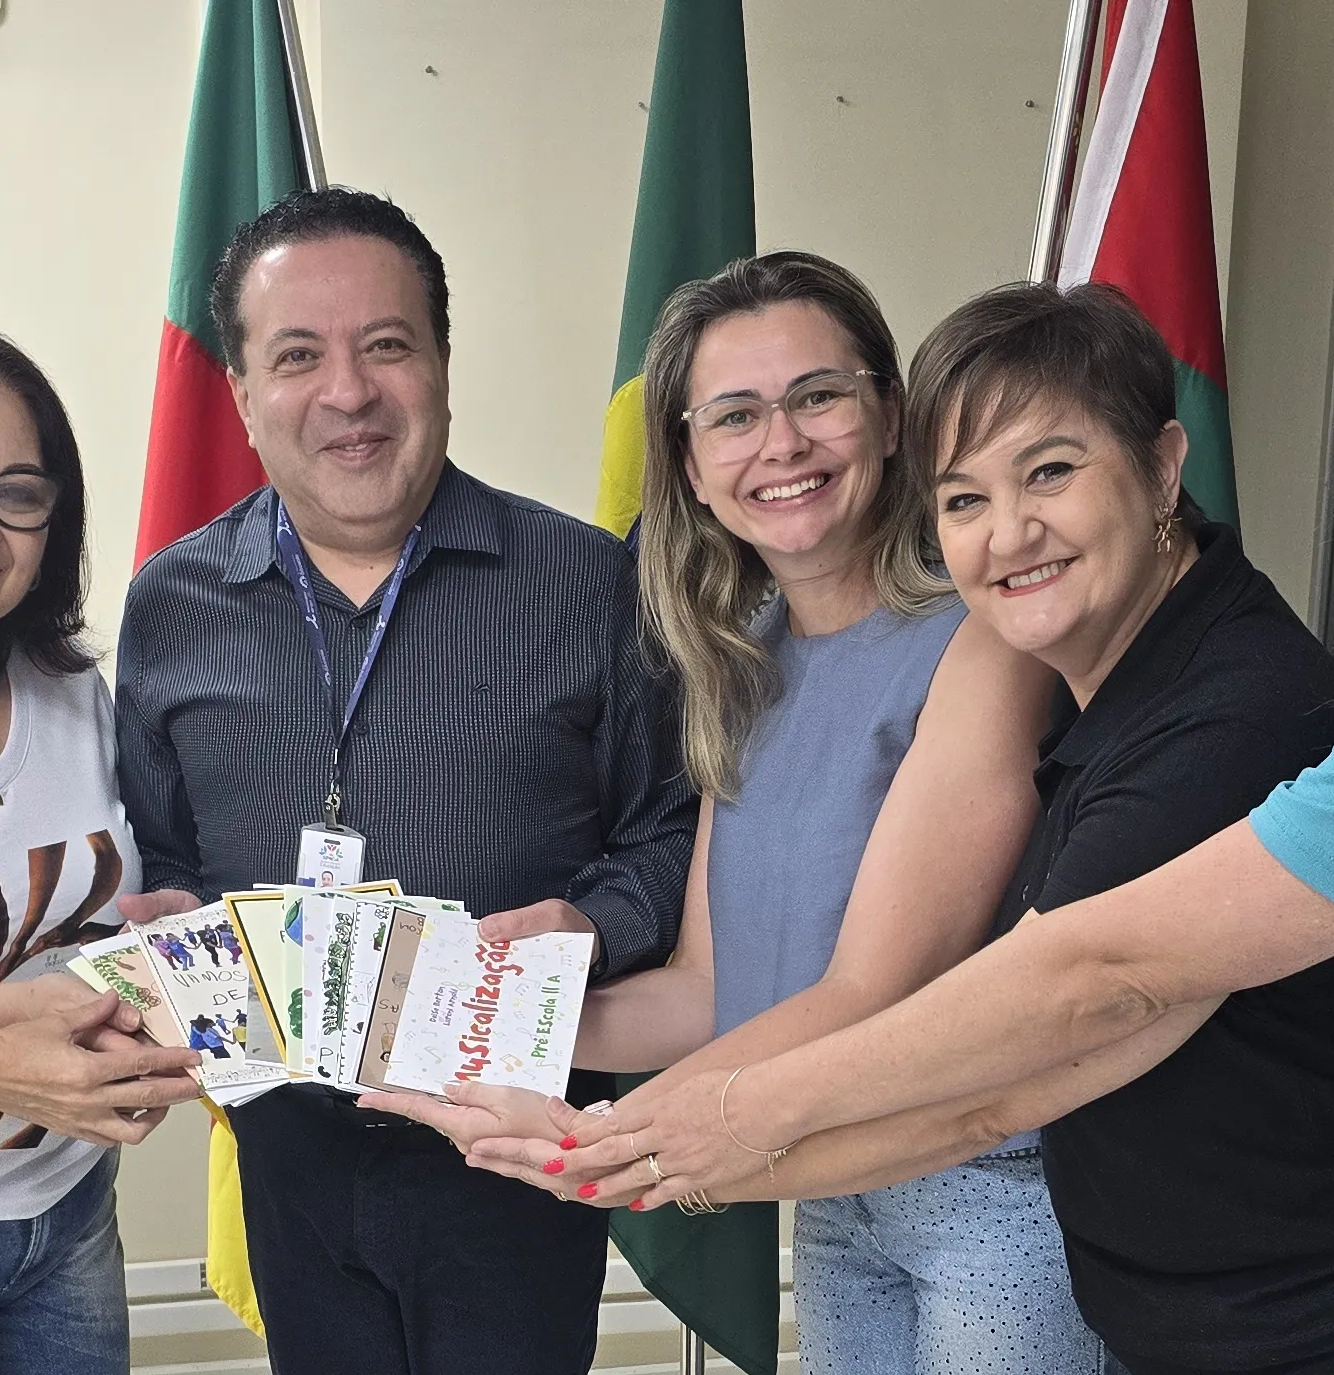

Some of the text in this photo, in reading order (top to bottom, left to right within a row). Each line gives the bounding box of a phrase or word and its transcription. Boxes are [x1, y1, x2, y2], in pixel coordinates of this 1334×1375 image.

[173, 971, 247, 987] VAMOS
[547, 974, 561, 984] A
[212, 988, 246, 1006] DE
